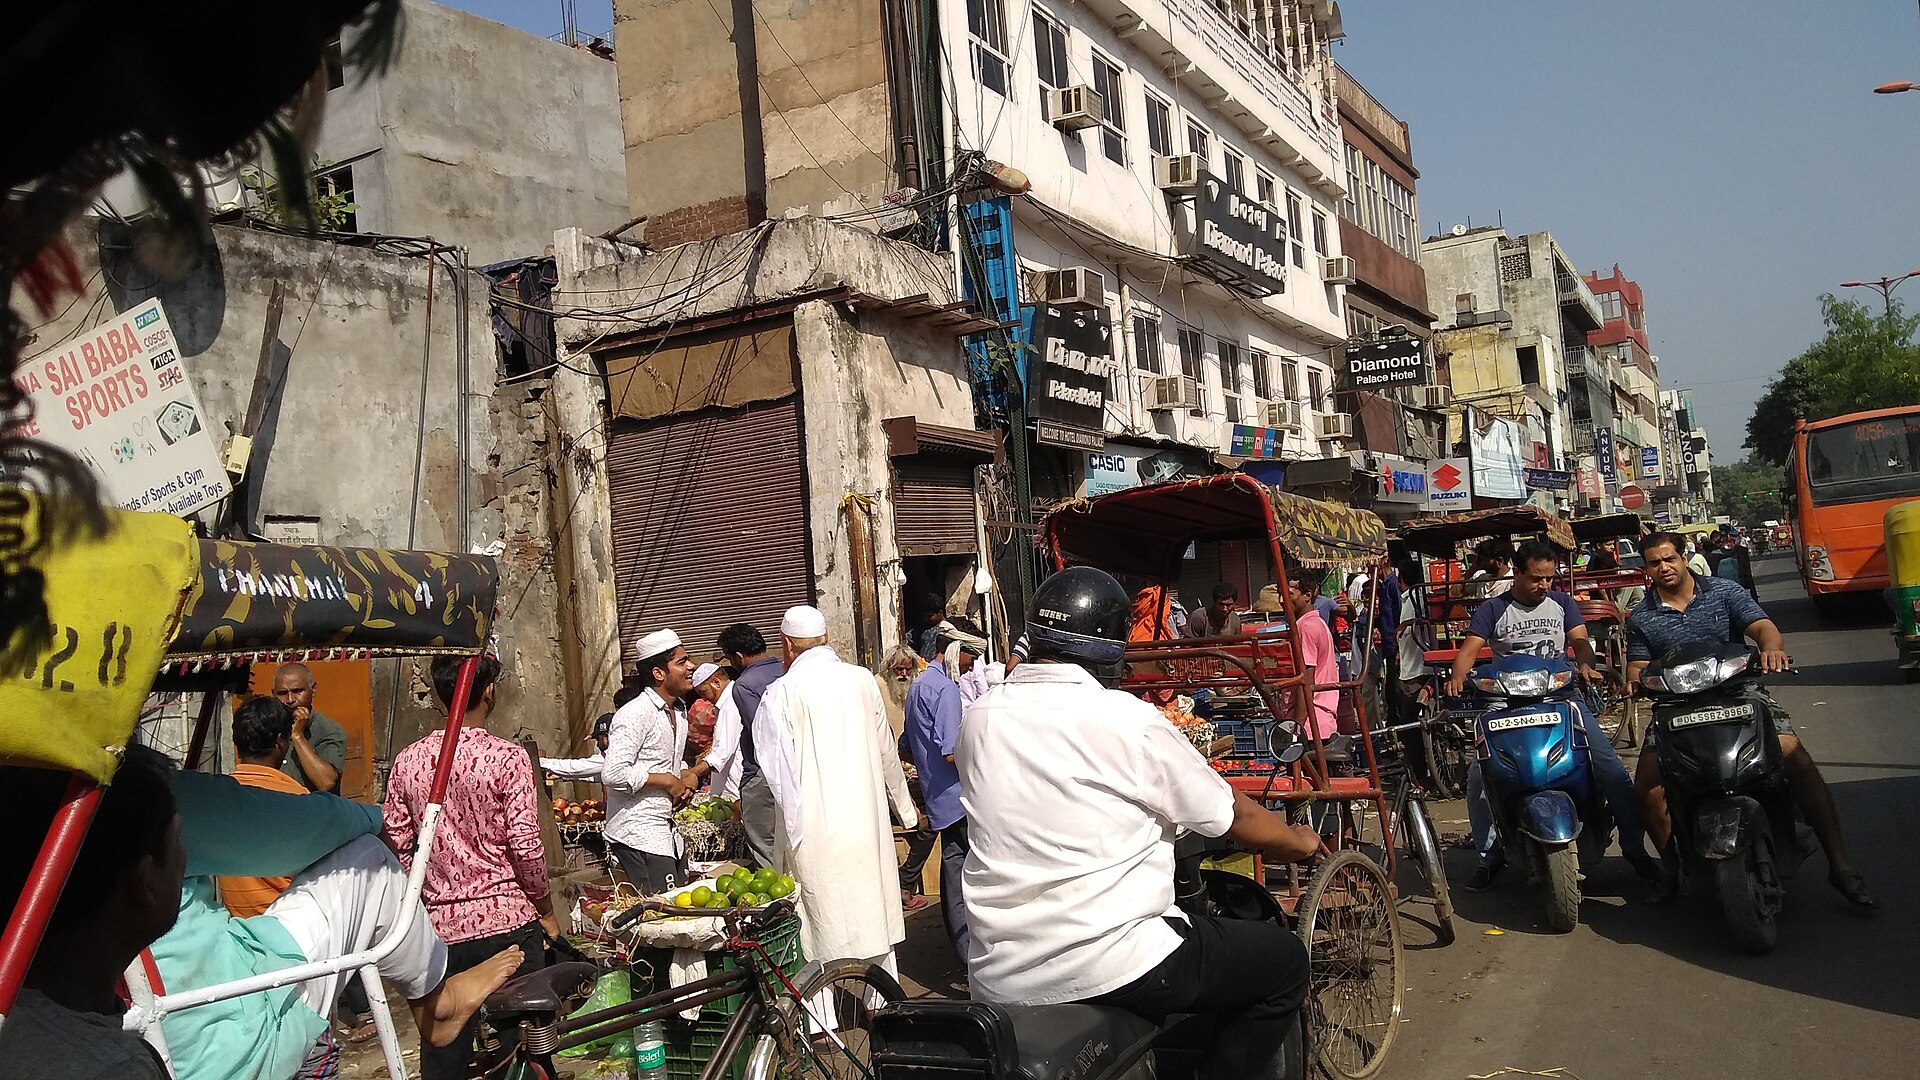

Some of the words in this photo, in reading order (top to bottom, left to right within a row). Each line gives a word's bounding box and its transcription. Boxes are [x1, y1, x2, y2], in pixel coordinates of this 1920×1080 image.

[1230, 194, 1267, 231] Hotel
[1203, 219, 1253, 266] Diamond
[1254, 247, 1287, 283] Palace
[143, 328, 167, 348] COSCO
[44, 350, 84, 396] SAI
[80, 322, 143, 378] BABA
[1046, 337, 1110, 378] Diamond
[1350, 352, 1421, 373] Diamond
[1357, 374, 1389, 385] Palace
[1390, 369, 1417, 381] Hotel
[65, 363, 149, 431] SPORTS
[1088, 453, 1126, 473] CASIO
[1600, 428, 1612, 473] ANKUR
[1680, 429, 1696, 474] SONY
[141, 490, 151, 506] of
[149, 481, 177, 503] Sports
[176, 475, 184, 489] &
[184, 468, 205, 486] Gym
[168, 490, 204, 514] Available
[202, 481, 224, 498] Toys
[1430, 491, 1467, 500] SUZUKI
[1505, 618, 1562, 635] CALIFORNIA
[638, 1049, 660, 1064] Bisleri
